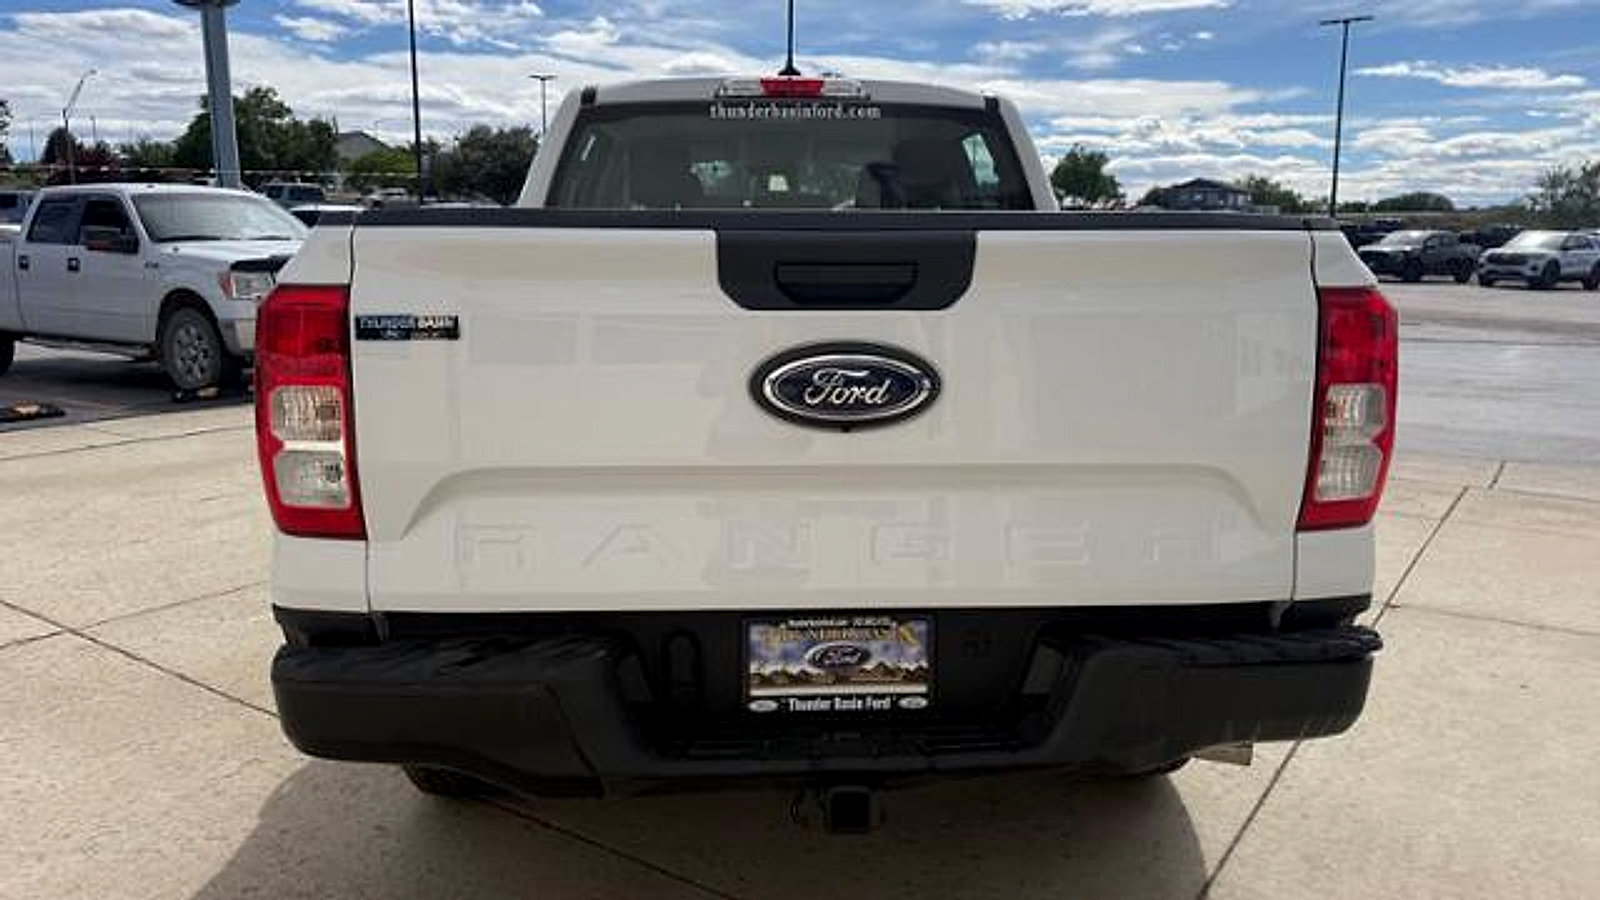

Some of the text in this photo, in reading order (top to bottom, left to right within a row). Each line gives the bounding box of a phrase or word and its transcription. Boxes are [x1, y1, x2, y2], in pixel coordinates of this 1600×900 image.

[709, 103, 881, 120] thunderbasinford.com
[804, 368, 890, 405] Ford
[454, 522, 1222, 573] RANGER
[865, 695, 892, 710] Ford
